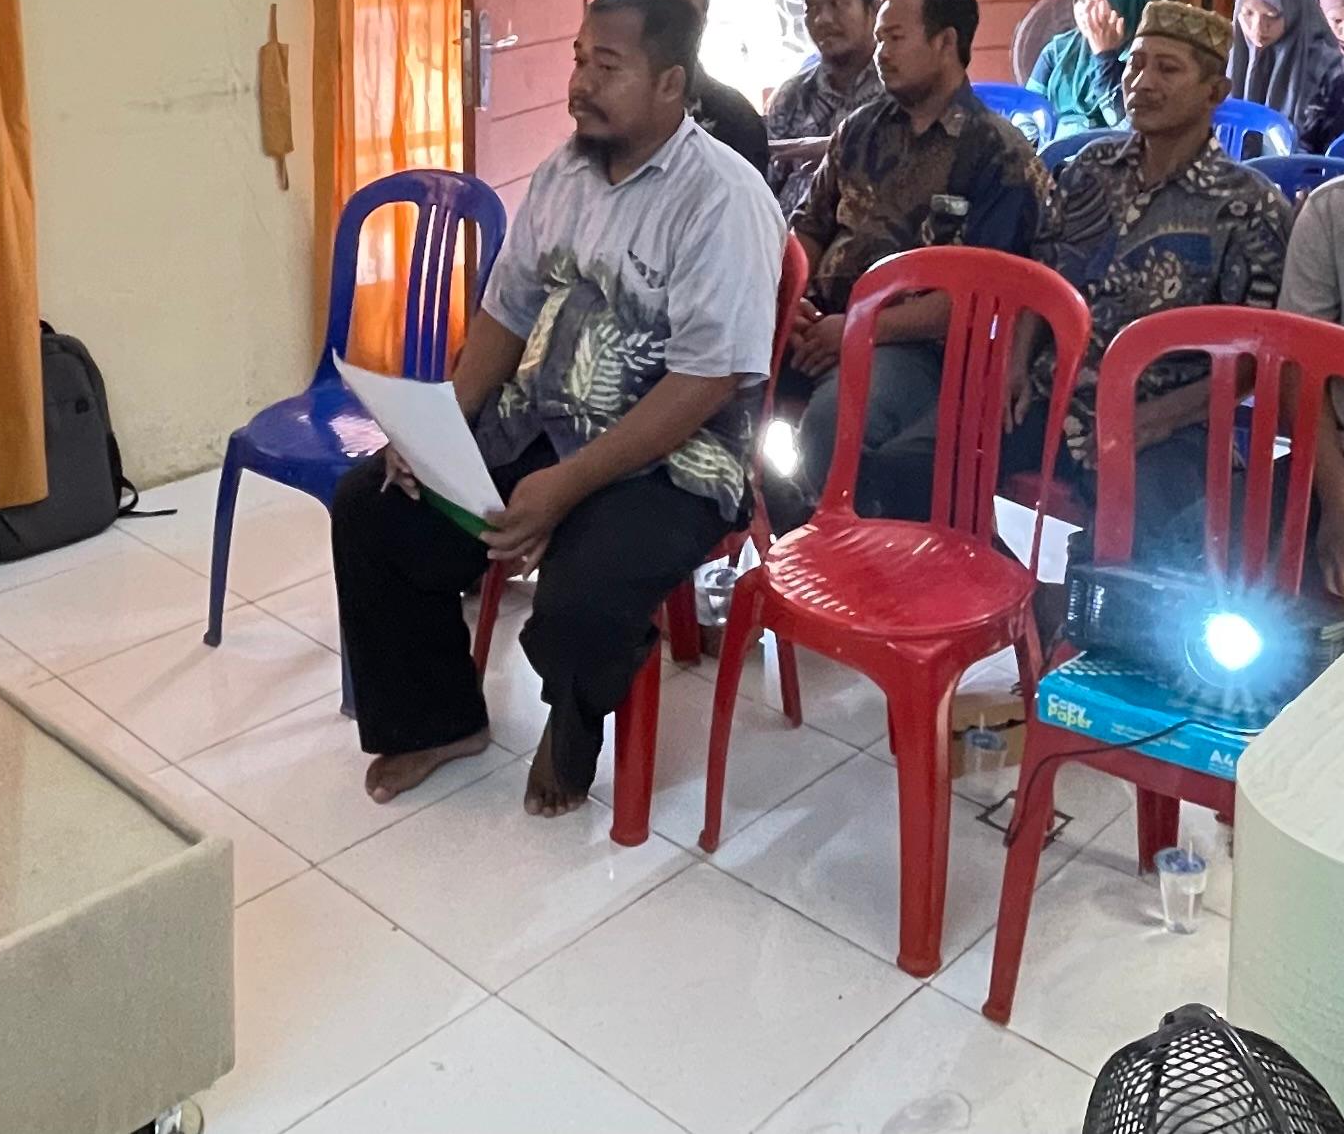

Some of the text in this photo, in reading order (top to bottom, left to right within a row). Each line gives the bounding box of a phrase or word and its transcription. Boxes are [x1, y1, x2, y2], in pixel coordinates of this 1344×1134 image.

[1047, 693, 1087, 717] Copy
[1047, 706, 1093, 729] Paper
[1209, 749, 1234, 767] A4
